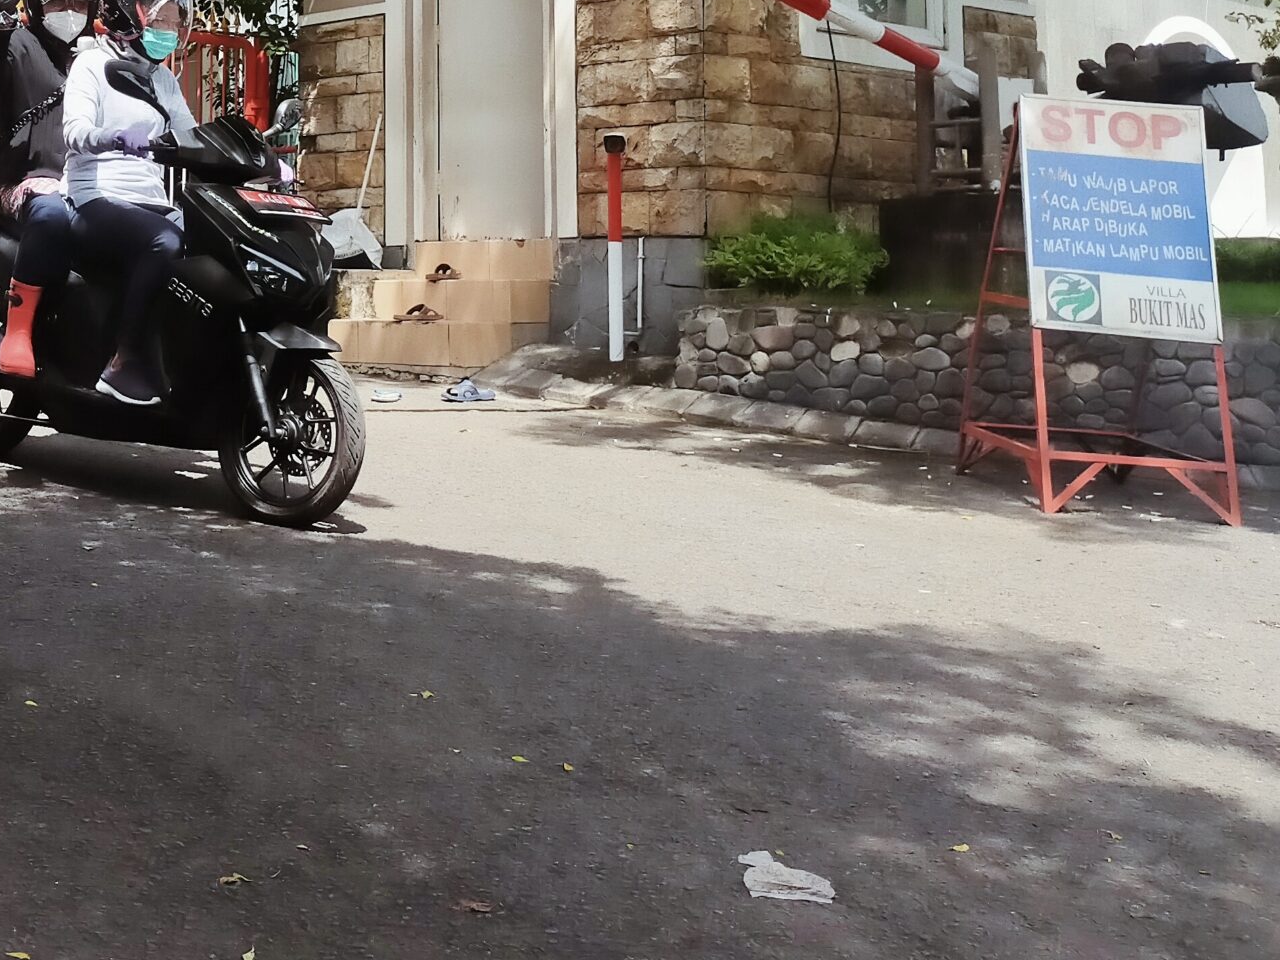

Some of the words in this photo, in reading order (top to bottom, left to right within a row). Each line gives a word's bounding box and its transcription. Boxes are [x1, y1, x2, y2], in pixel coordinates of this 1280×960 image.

[1040, 104, 1183, 151] STOP
[1082, 171, 1127, 196] WAJIB
[1130, 179, 1180, 195] LAPOR
[1082, 195, 1148, 218] JENDELA
[1151, 204, 1196, 221] MOBIL
[1041, 209, 1091, 232] HARAP
[1094, 218, 1149, 237] DIBUKA
[1043, 239, 1106, 258] MATIKAN
[1109, 244, 1160, 262] LAMPU
[1162, 246, 1209, 262] MOBIL
[168, 277, 213, 317] GESITS
[1145, 285, 1187, 300] VILLA
[1128, 297, 1171, 327] BUKIT
[1175, 301, 1207, 331] MAS
